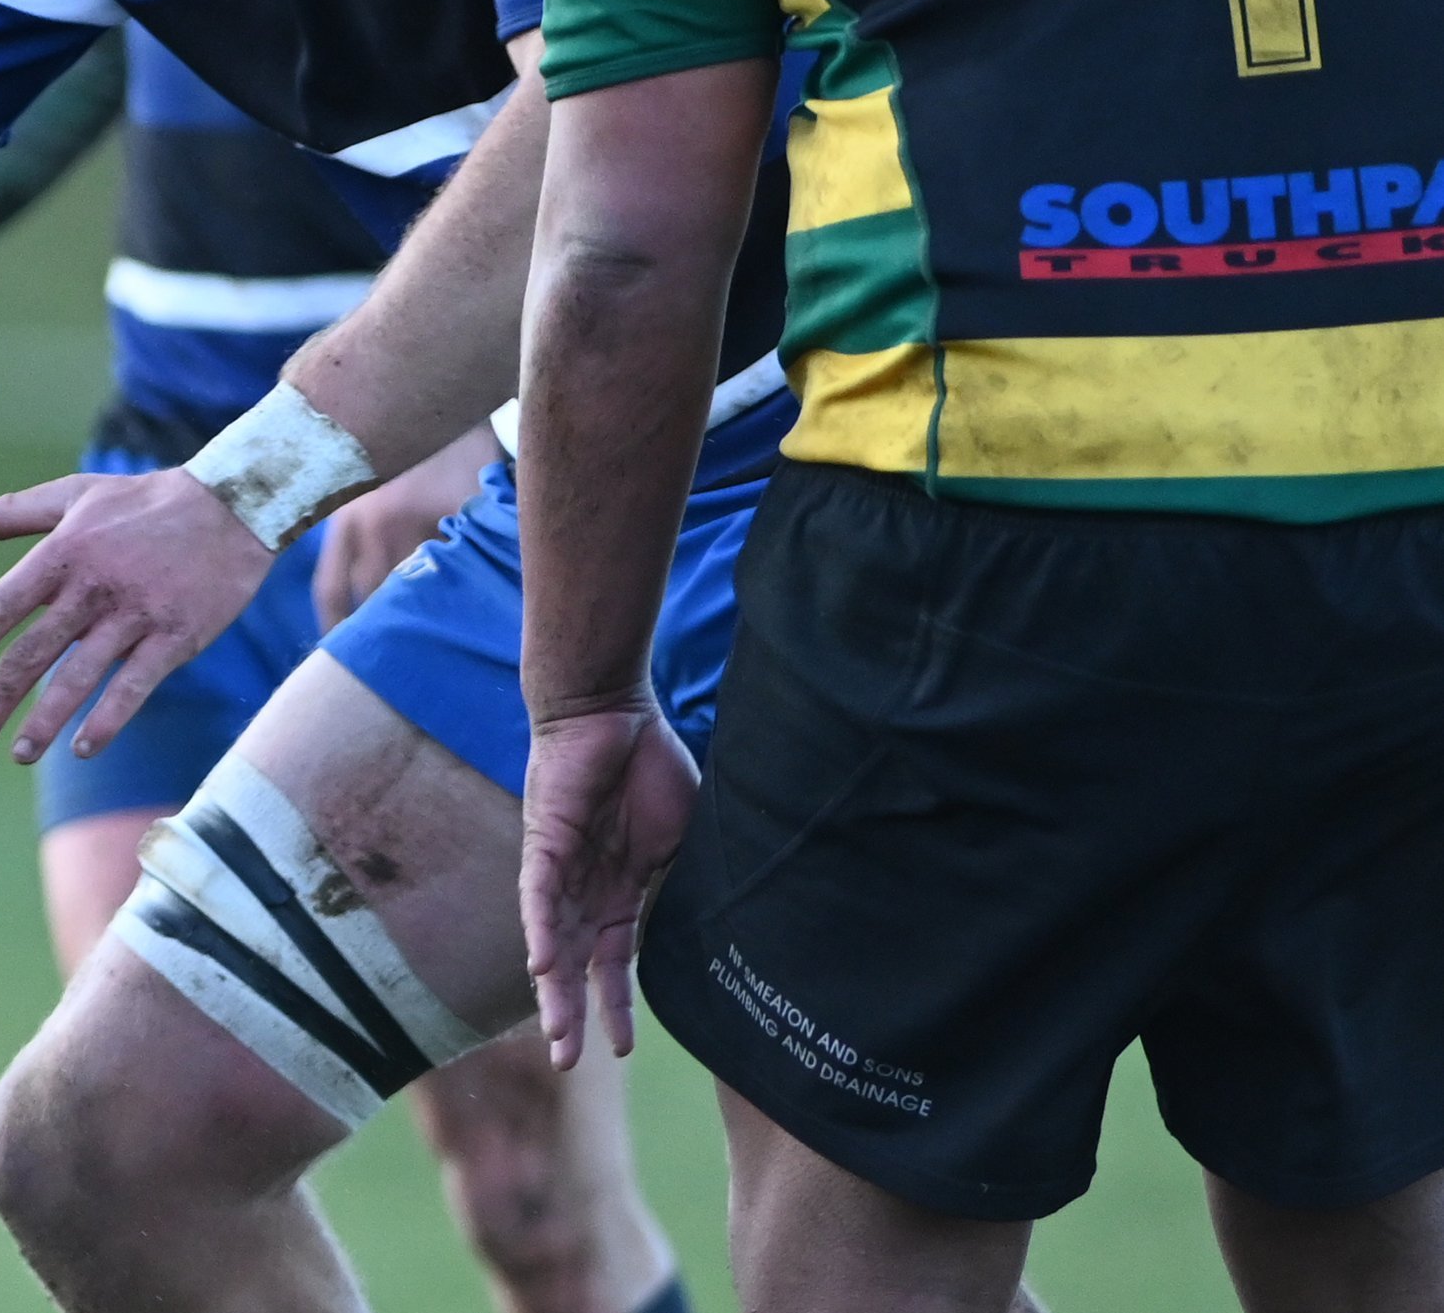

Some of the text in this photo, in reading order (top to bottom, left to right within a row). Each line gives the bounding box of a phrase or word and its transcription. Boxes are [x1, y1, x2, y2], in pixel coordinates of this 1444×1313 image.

[709, 957, 933, 1117] PLUMBING AND DRAINAGE
[743, 965, 815, 1039] SMEATON
[817, 1032, 858, 1065] AND
[862, 1058, 925, 1087] SONS
